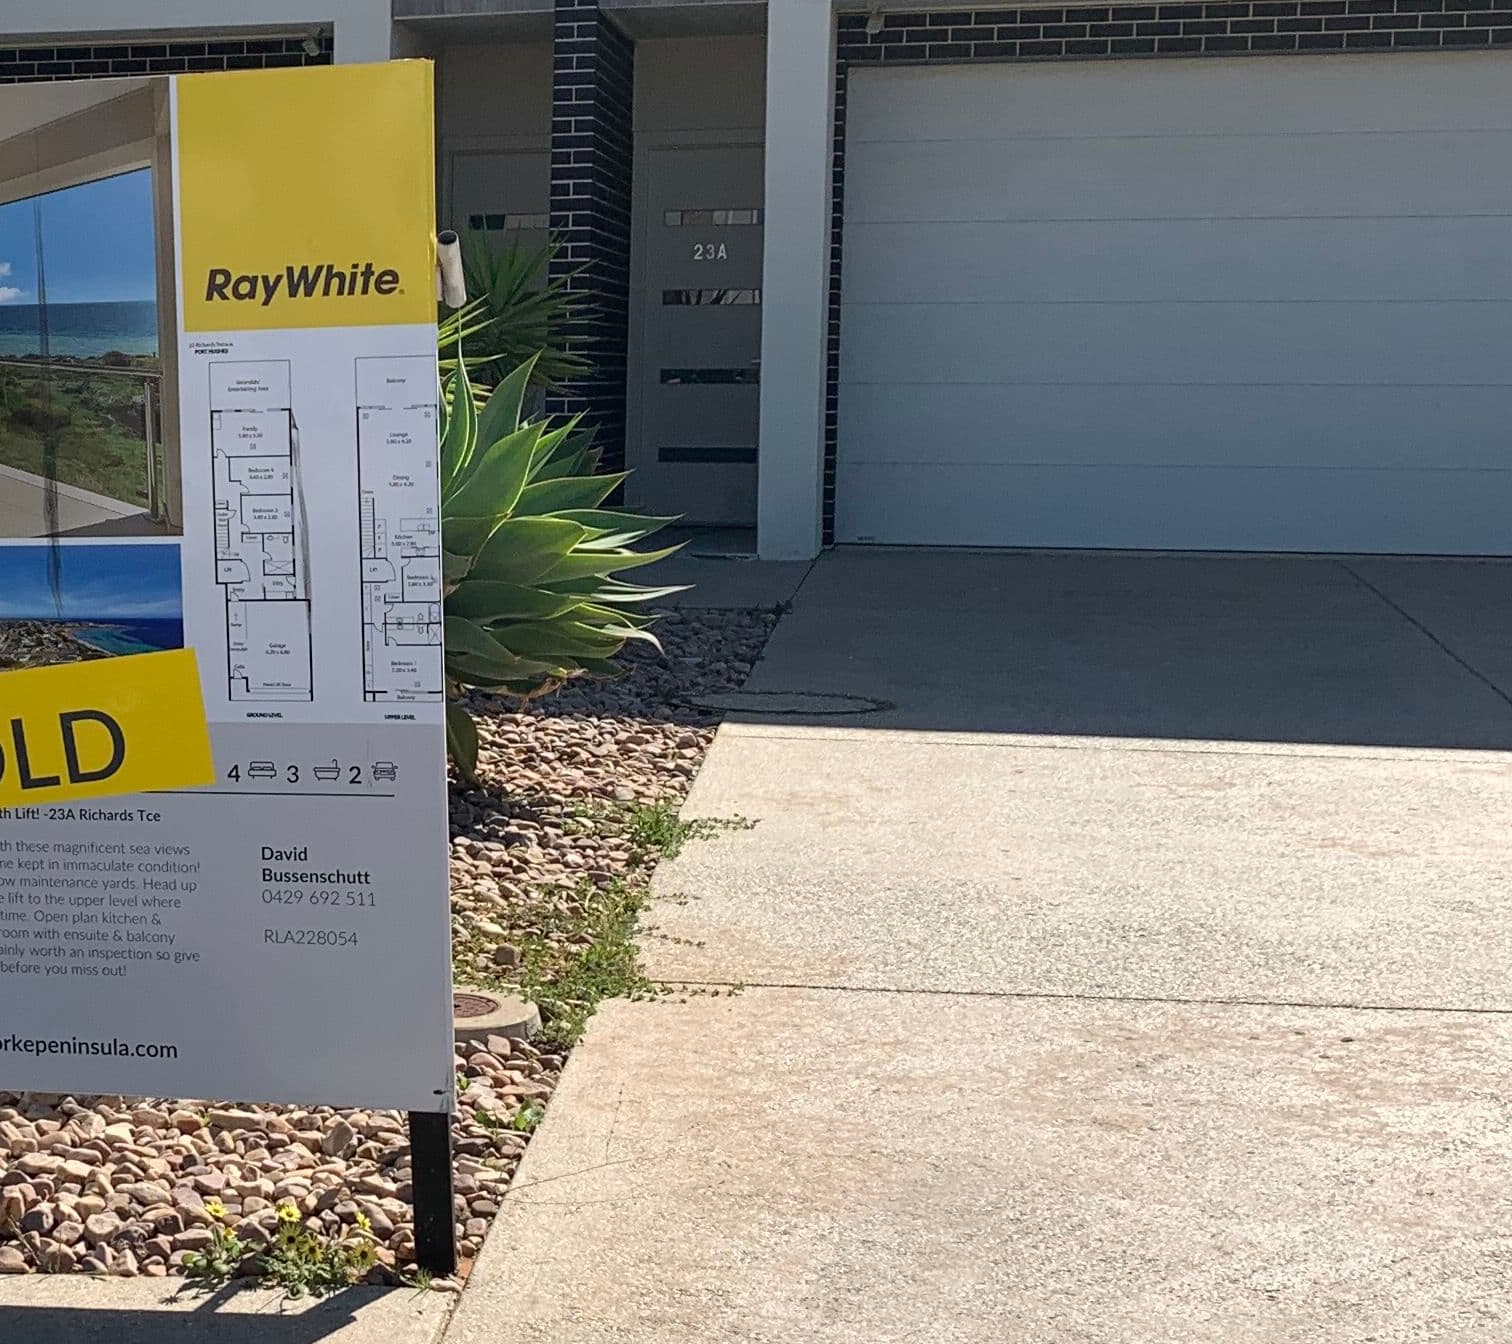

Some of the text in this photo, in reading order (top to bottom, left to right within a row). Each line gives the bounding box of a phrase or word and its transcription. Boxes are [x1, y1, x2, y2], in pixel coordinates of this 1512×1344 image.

[694, 244, 727, 260] 23A
[227, 764, 362, 784] 4 3 2
[16, 808, 39, 820] Lift!
[44, 809, 75, 820] -23A
[80, 809, 133, 821] Richards
[138, 809, 161, 822] Tce
[16, 841, 49, 853] these
[53, 841, 125, 856] magnificent
[130, 845, 150, 855] sea
[154, 845, 190, 855] views
[261, 847, 308, 861] David
[18, 858, 44, 872] kept
[48, 859, 59, 870] in
[64, 859, 134, 872] immaculate
[138, 861, 200, 873] condition!
[20, 876, 98, 889] maintenance
[102, 878, 137, 891] yards.
[143, 878, 176, 891] Head
[181, 882, 197, 893] up
[262, 868, 371, 885] Bussenschutt
[9, 893, 24, 905] lift
[29, 894, 40, 905] to
[45, 894, 65, 906] the
[69, 897, 104, 908] upper
[109, 894, 138, 907] level
[142, 896, 181, 908] where
[261, 889, 376, 906] 0429 692 511
[0, 910, 27, 921] time.
[34, 910, 68, 924] Open
[72, 911, 98, 925] plan
[102, 912, 147, 925] kitchen
[151, 914, 161, 925] &
[33, 928, 59, 940] with
[64, 929, 109, 941] ensuite
[113, 930, 122, 941] &
[127, 930, 175, 944] balcony
[264, 929, 358, 946] RLA228054
[29, 944, 66, 956] worth
[70, 948, 84, 957] an
[88, 947, 152, 960] inspection
[156, 950, 170, 960] so
[175, 951, 200, 963] give
[1, 961, 40, 974] before
[45, 965, 67, 976] you
[71, 964, 98, 975] miss
[102, 965, 127, 976] out!
